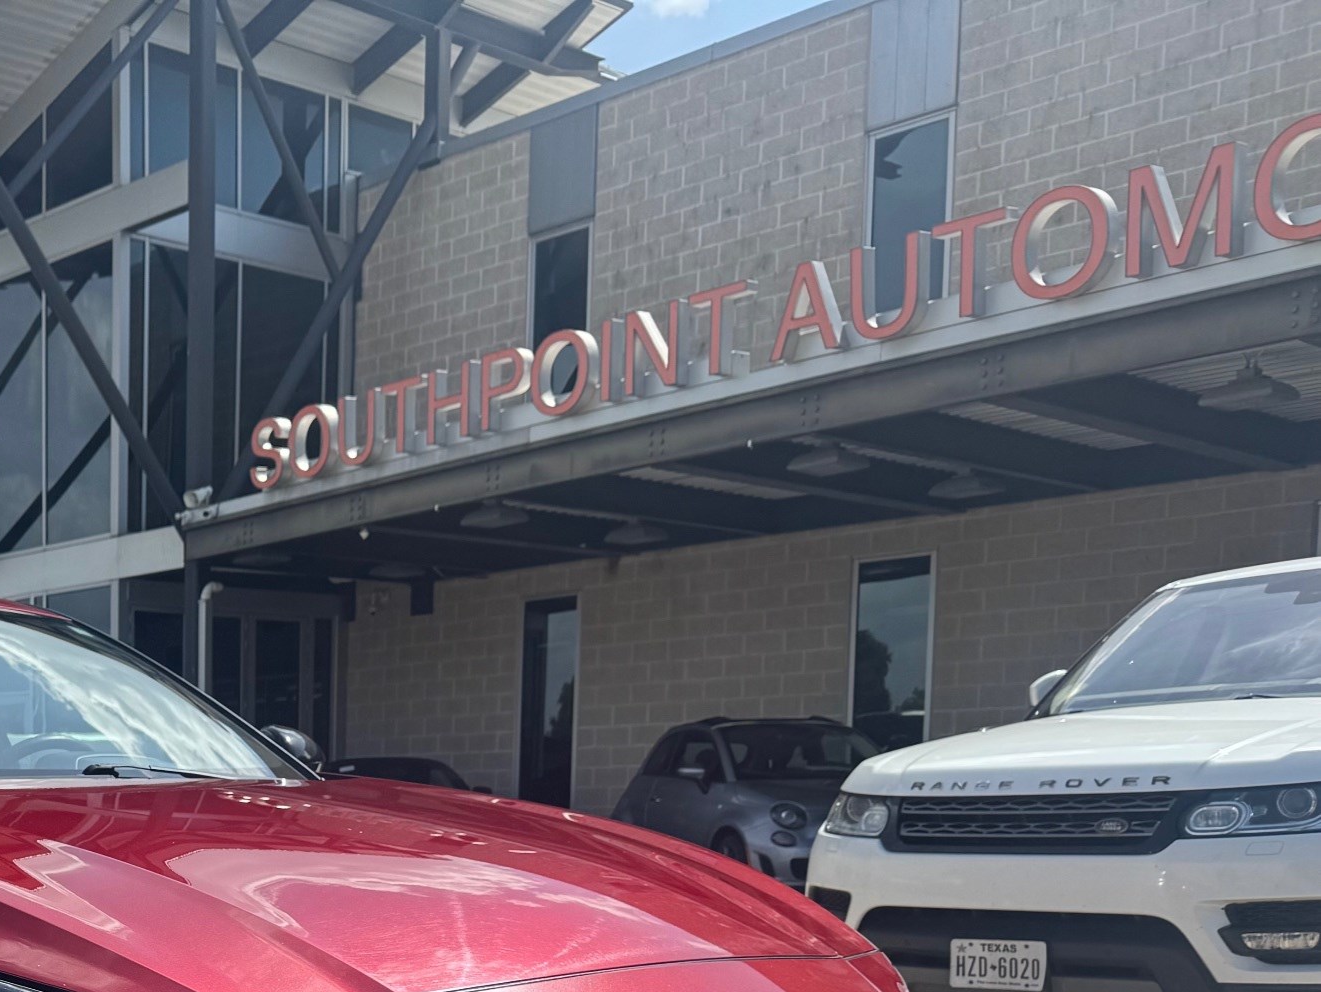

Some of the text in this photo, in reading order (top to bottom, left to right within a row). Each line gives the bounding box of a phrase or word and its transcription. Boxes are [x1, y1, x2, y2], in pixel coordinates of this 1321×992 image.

[250, 280, 758, 490] SOUTHPOINT
[910, 775, 1172, 791] RANGE ROVER
[979, 943, 1017, 953] TEXAS
